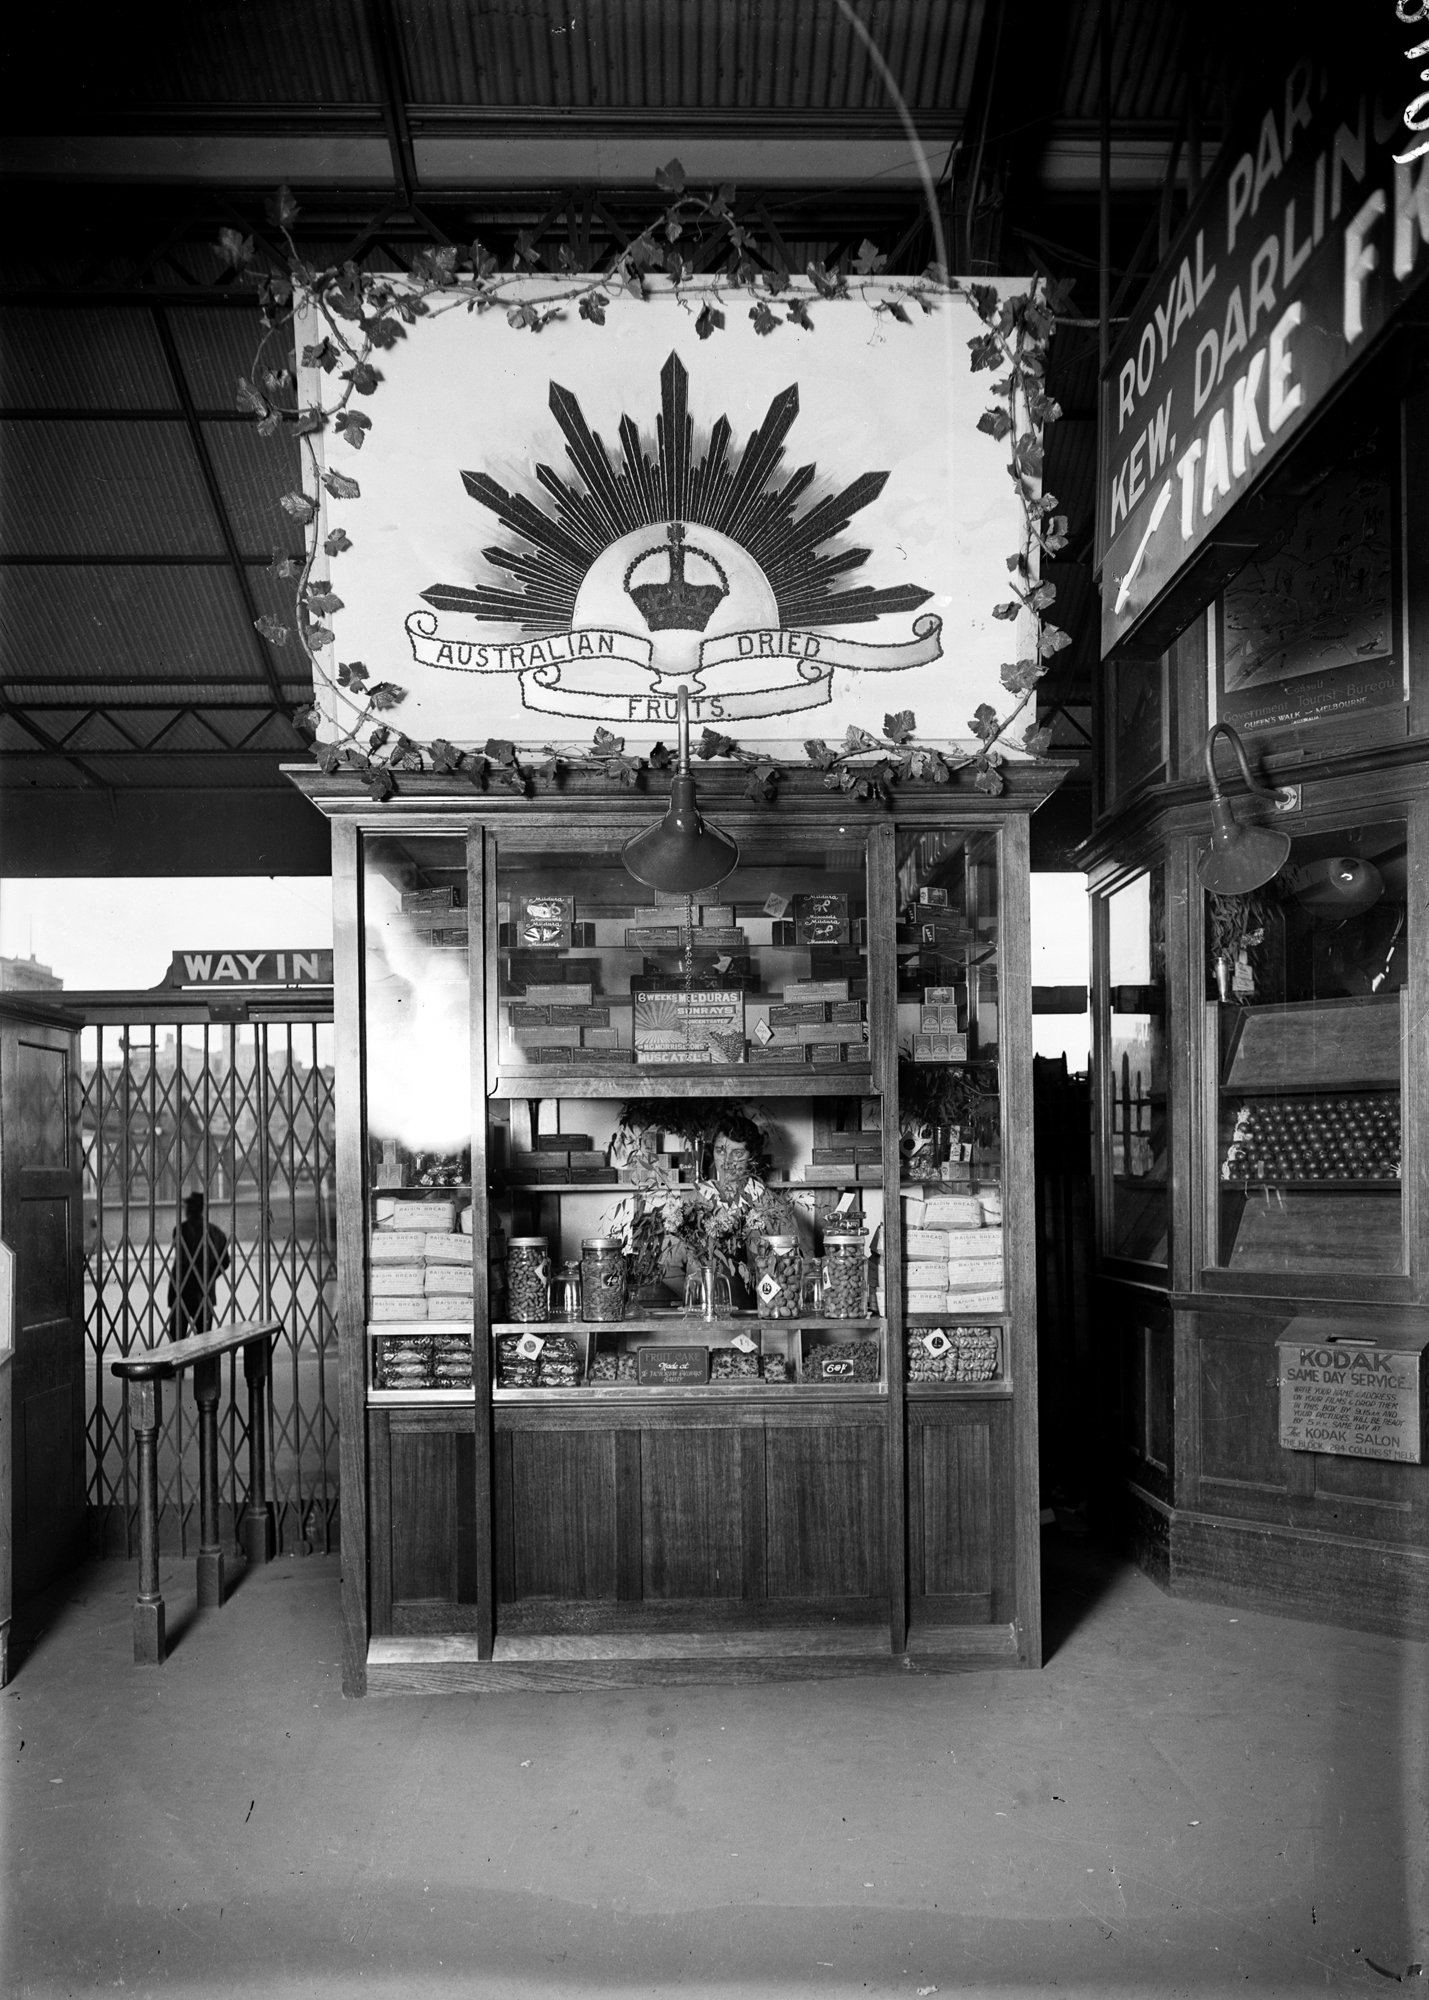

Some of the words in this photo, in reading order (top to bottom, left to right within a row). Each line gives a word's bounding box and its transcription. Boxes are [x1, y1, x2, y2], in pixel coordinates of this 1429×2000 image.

[1120, 229, 1216, 434] ROYAL
[1176, 301, 1303, 541] TAKE
[1110, 390, 1177, 537] KEW,
[436, 633, 615, 668] AUSTRALIAN
[737, 632, 821, 658] DRIED
[628, 697, 733, 719] FRUTS.
[1223, 701, 1289, 724] Government
[1297, 689, 1336, 708] Tourist
[1347, 678, 1396, 697] Bureau
[1244, 716, 1278, 731] QUEEN'S
[1278, 711, 1301, 722] WALK
[183, 953, 267, 982] WAY
[276, 952, 320, 981] IN
[638, 992, 647, 1003] 6
[647, 993, 678, 1003] WEEKS
[679, 992, 738, 1003] MLDURAS
[677, 1006, 734, 1015] SUNRAYS
[638, 1052, 710, 1063] MUSCATELS
[645, 1352, 672, 1362] FRUIT
[675, 1352, 701, 1362] CAKE
[1299, 1349, 1393, 1374] KODAK
[1287, 1368, 1320, 1383] SAME
[1323, 1371, 1347, 1384] DAY
[1293, 1385, 1311, 1394] WRITE
[1314, 1387, 1332, 1396] YOUR
[1333, 1389, 1354, 1398] NAME
[1360, 1391, 1397, 1402] ADDRESS
[1304, 1394, 1324, 1403] YOUR
[1324, 1396, 1347, 1405] FILMS
[1355, 1399, 1377, 1408] DROP
[1378, 1401, 1399, 1410] THEM
[1293, 1409, 1313, 1418] YOUR
[1315, 1410, 1351, 1422] PICTURES
[1352, 1415, 1369, 1424] WILL
[1370, 1417, 1381, 1425] BE
[1383, 1418, 1406, 1428] READY
[1303, 1403, 1320, 1411] THIS
[1322, 1404, 1338, 1413] BOX
[1340, 1406, 1351, 1414] BY
[1382, 1410, 1398, 1419] AND
[1292, 1417, 1304, 1425] BY
[1307, 1418, 1315, 1426] 5
[1332, 1420, 1353, 1430] SAME
[1354, 1423, 1371, 1432] DAY
[1305, 1427, 1348, 1443] KODAK
[1355, 1432, 1401, 1448] SALON
[1282, 1438, 1297, 1446] THE
[1298, 1440, 1324, 1450] BLOCK
[1329, 1443, 1346, 1453] 284
[1349, 1446, 1383, 1458] COLLINS
